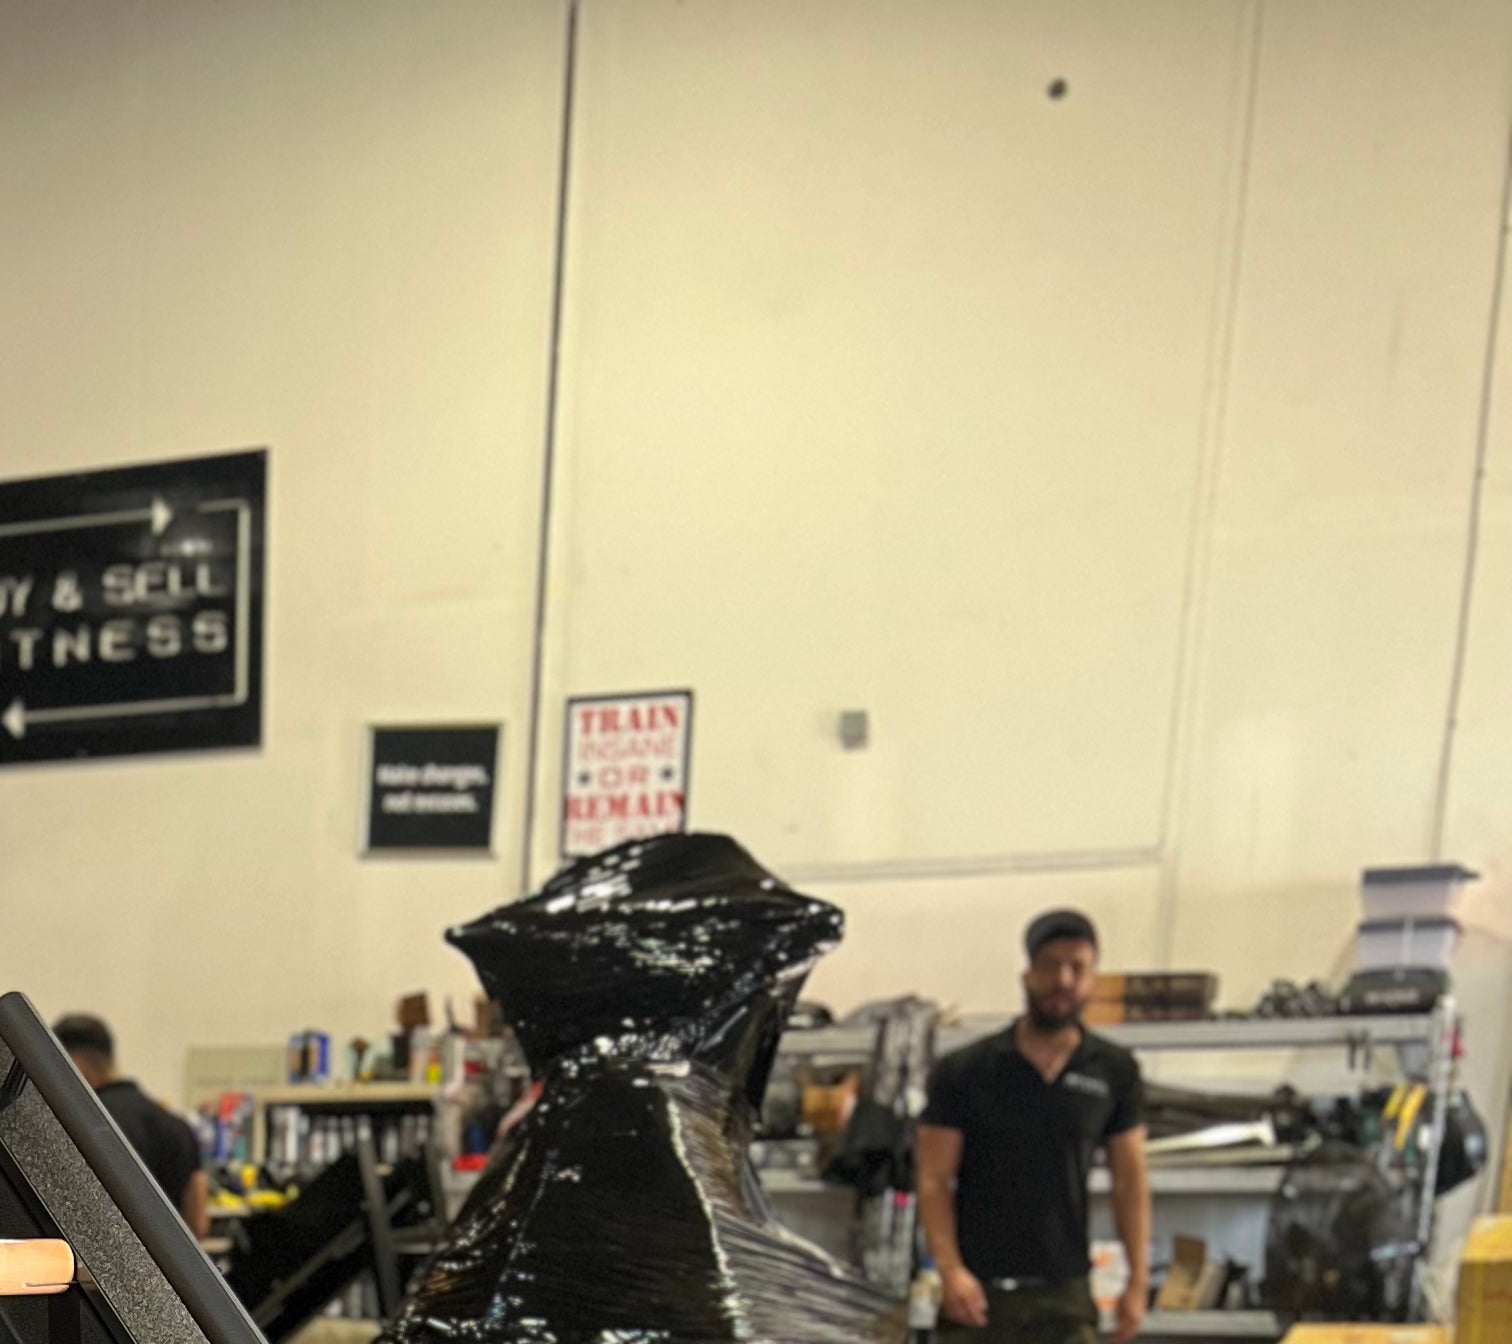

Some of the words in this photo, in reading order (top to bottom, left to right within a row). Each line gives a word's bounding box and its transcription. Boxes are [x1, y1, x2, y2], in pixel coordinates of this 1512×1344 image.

[52, 570, 83, 613] &
[102, 561, 228, 606] SELL
[580, 705, 678, 735] TRAIN
[599, 765, 648, 789] OR
[565, 791, 684, 820] REMAIN
